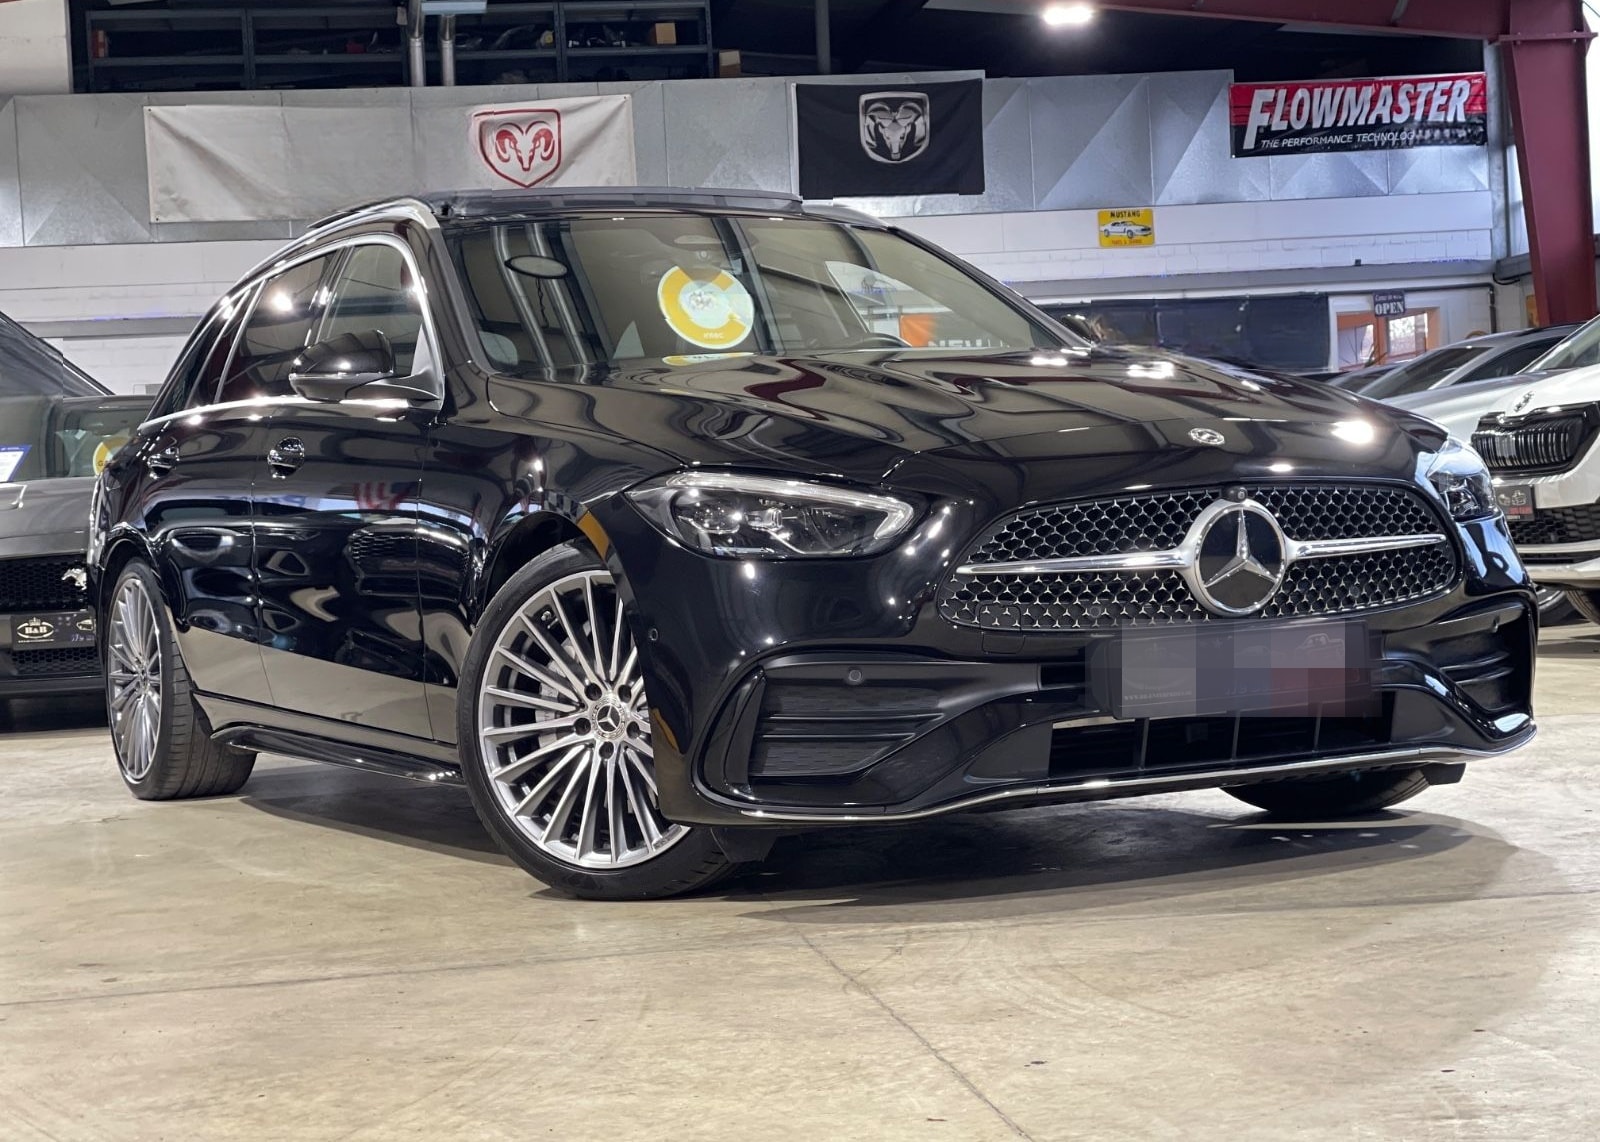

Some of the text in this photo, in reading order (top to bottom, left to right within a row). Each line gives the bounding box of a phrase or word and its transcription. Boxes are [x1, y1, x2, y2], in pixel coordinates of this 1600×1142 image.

[1243, 79, 1471, 150] FLOWMASTER
[1260, 139, 1281, 149] THE
[1282, 134, 1354, 147] PERFORMANCE
[1110, 210, 1141, 218] MUSTANG
[1374, 301, 1404, 315] OPEN
